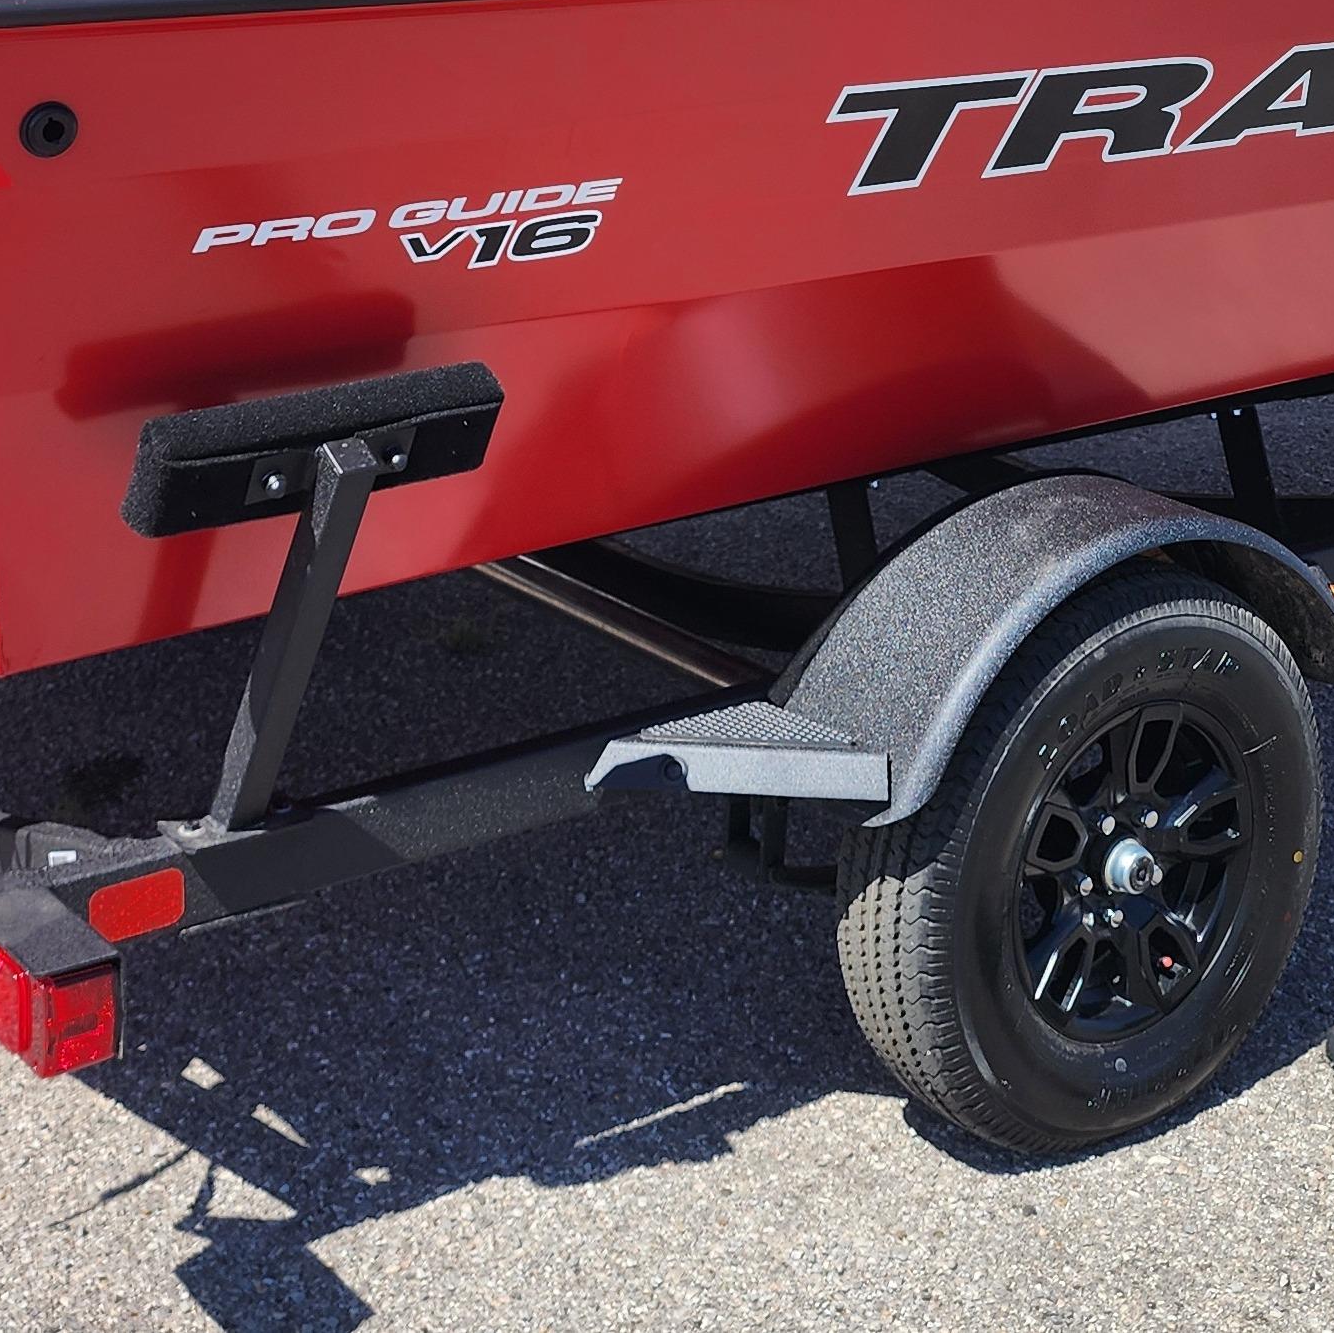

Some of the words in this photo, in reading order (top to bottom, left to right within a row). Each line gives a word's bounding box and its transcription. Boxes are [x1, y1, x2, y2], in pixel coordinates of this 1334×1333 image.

[192, 210, 376, 253] PRO
[388, 177, 623, 229] GUIDE
[399, 210, 602, 269] V16
